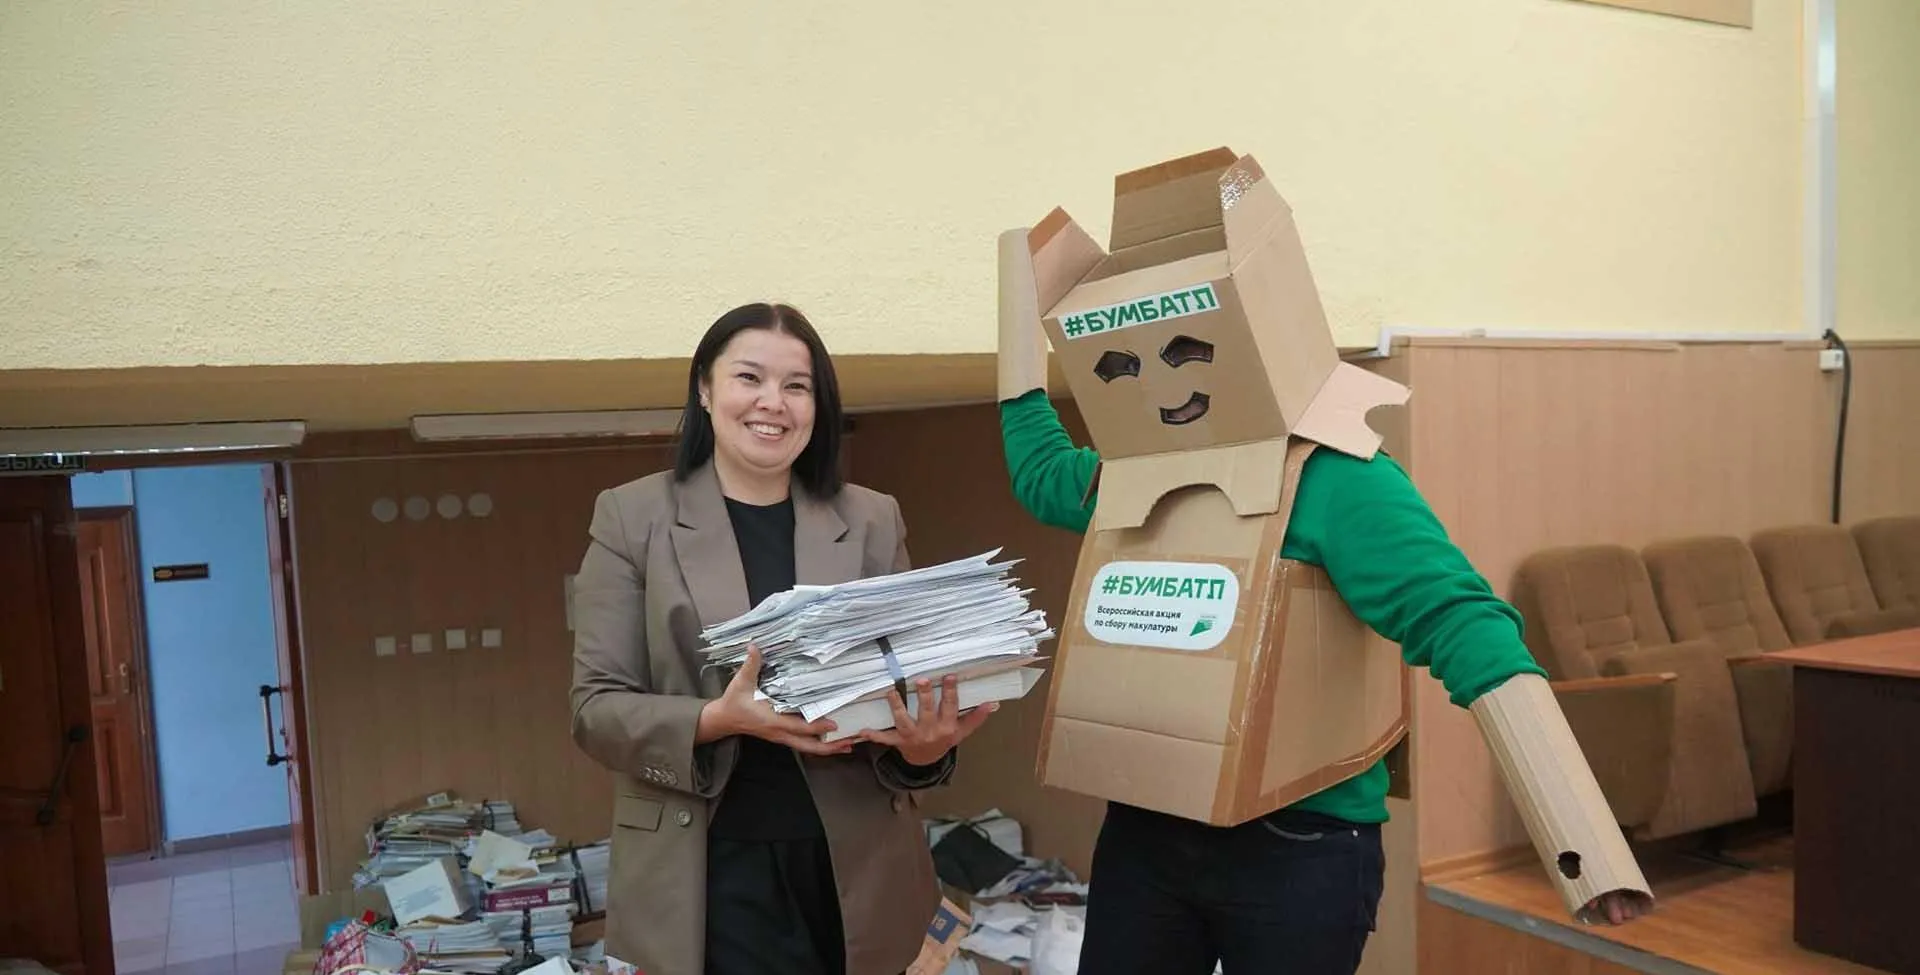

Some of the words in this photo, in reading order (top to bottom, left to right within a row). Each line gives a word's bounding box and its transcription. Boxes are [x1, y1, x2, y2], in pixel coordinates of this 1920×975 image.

[1097, 605, 1154, 617] Всероссийская
[1155, 610, 1181, 619] акция
[1104, 619, 1127, 630] сбору
[1128, 622, 1178, 633] макулатуры
